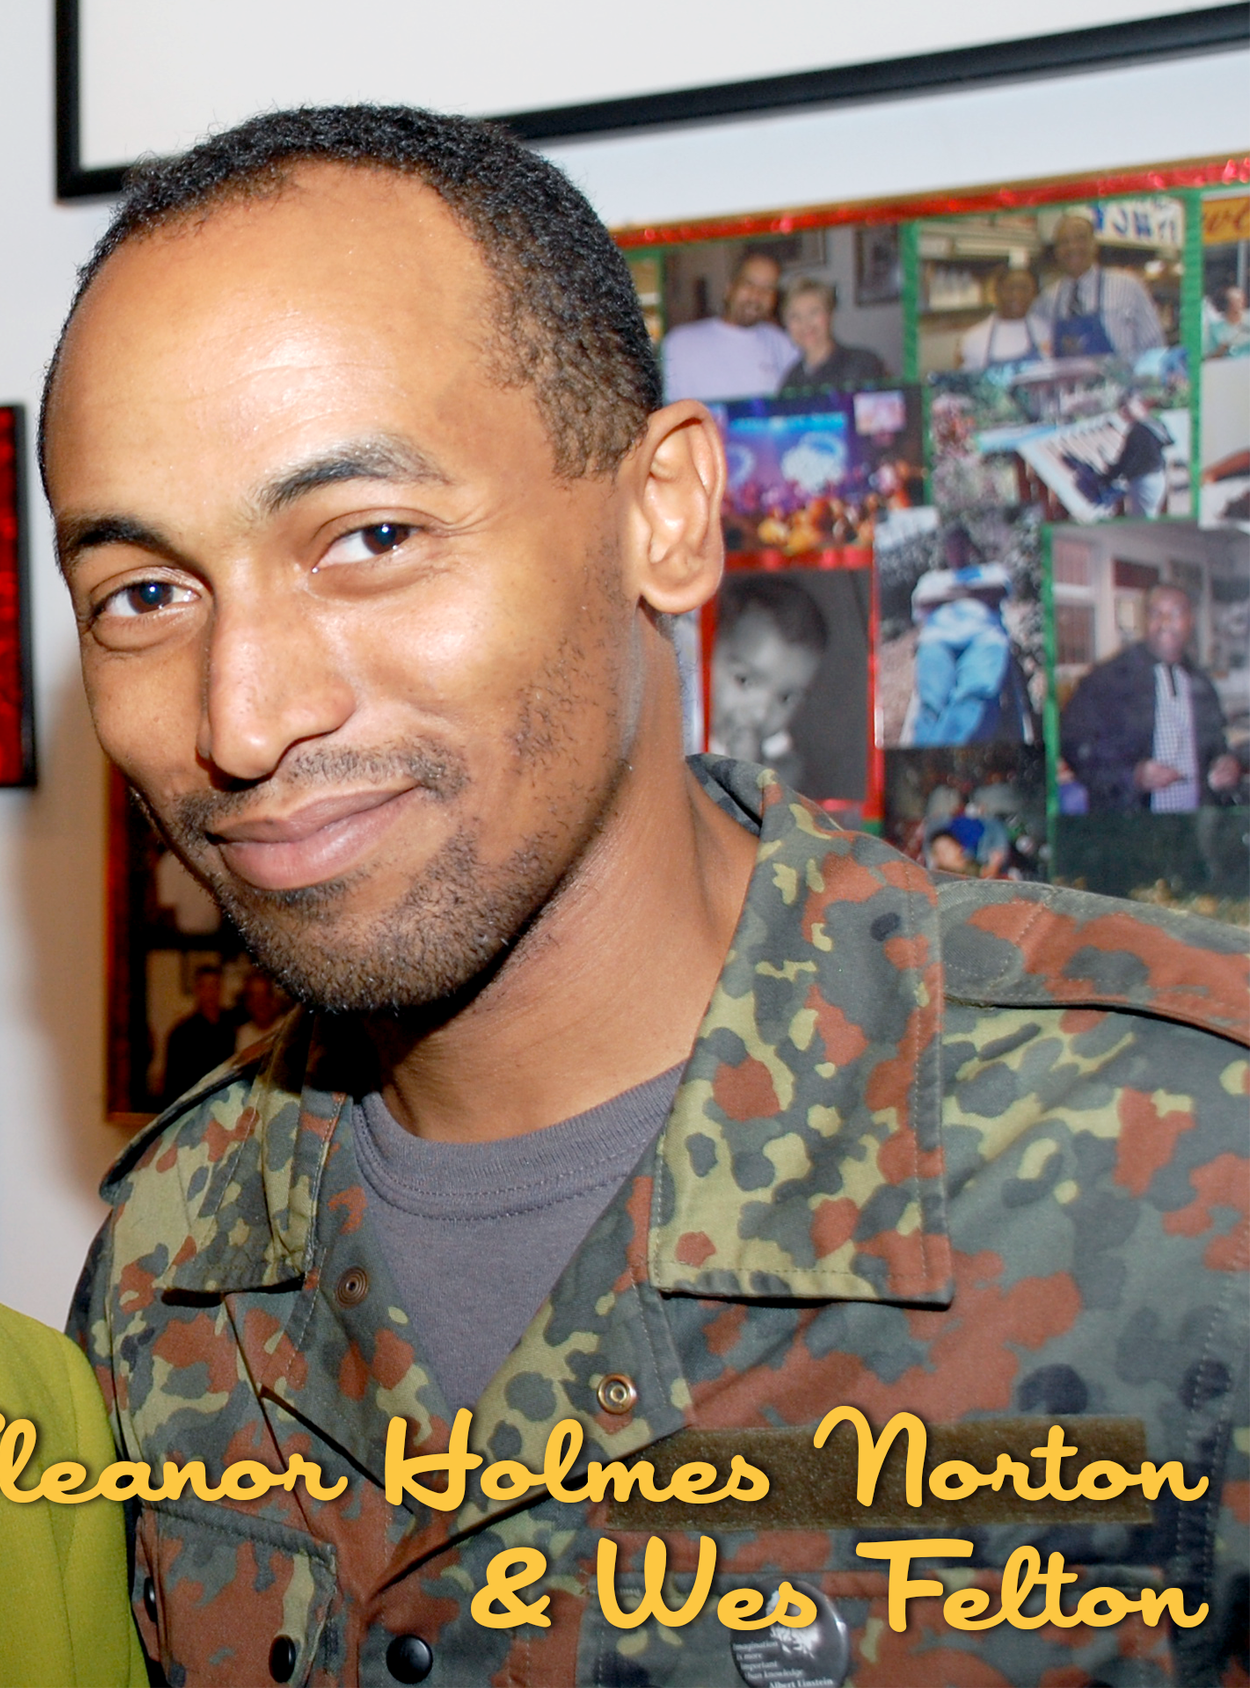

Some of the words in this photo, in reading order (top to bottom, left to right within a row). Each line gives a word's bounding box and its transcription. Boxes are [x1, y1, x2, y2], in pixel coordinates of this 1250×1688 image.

[741, 1661, 778, 1671] important
[764, 1668, 804, 1679] knowledge
[769, 1679, 796, 1688] Albert
